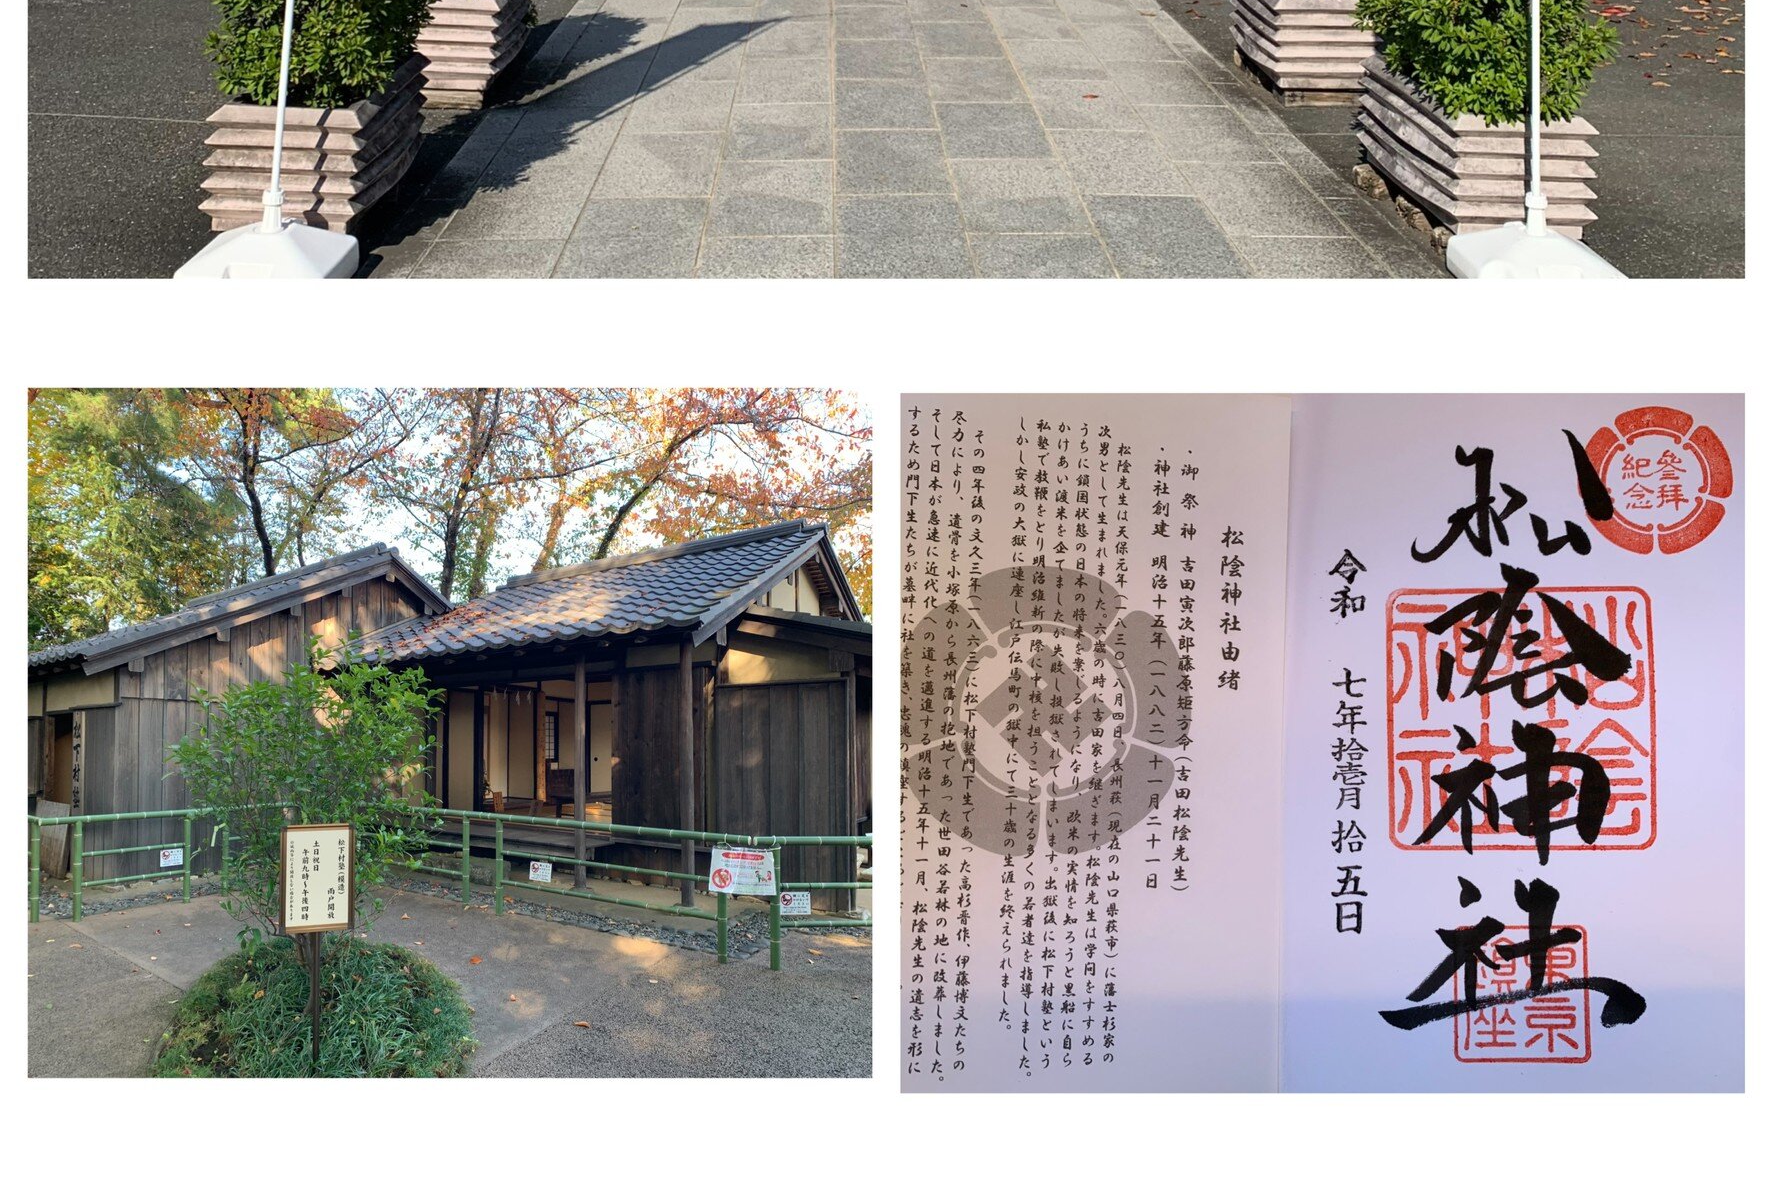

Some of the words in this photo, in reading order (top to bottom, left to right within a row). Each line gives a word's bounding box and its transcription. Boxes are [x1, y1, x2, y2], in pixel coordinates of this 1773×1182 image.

[1217, 525, 1245, 691] 松陰神社由緒
[1328, 548, 1368, 618] 令和
